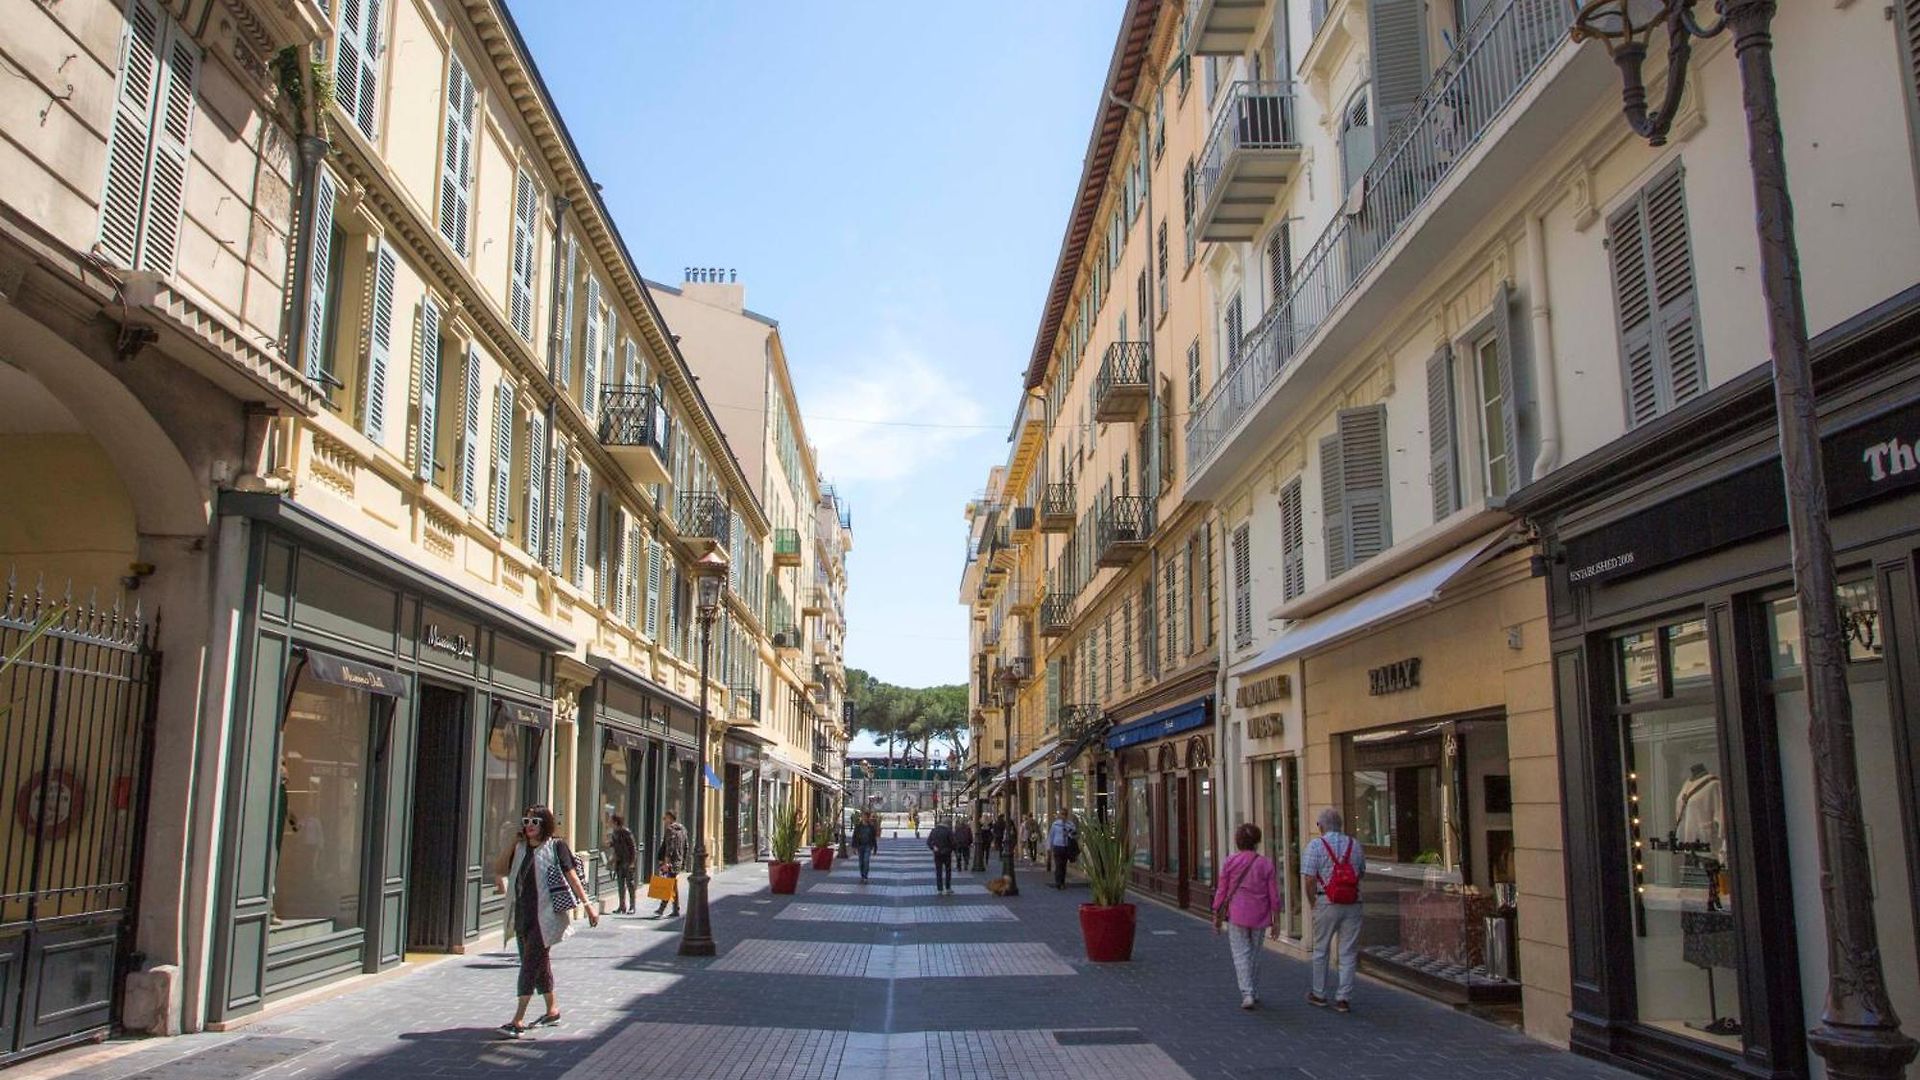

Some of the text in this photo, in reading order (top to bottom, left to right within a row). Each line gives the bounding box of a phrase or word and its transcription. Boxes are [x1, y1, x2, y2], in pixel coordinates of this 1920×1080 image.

[1863, 437, 1920, 481] Th
[1570, 557, 1618, 581] ESTABLISHED
[1368, 657, 1421, 696] BALLY
